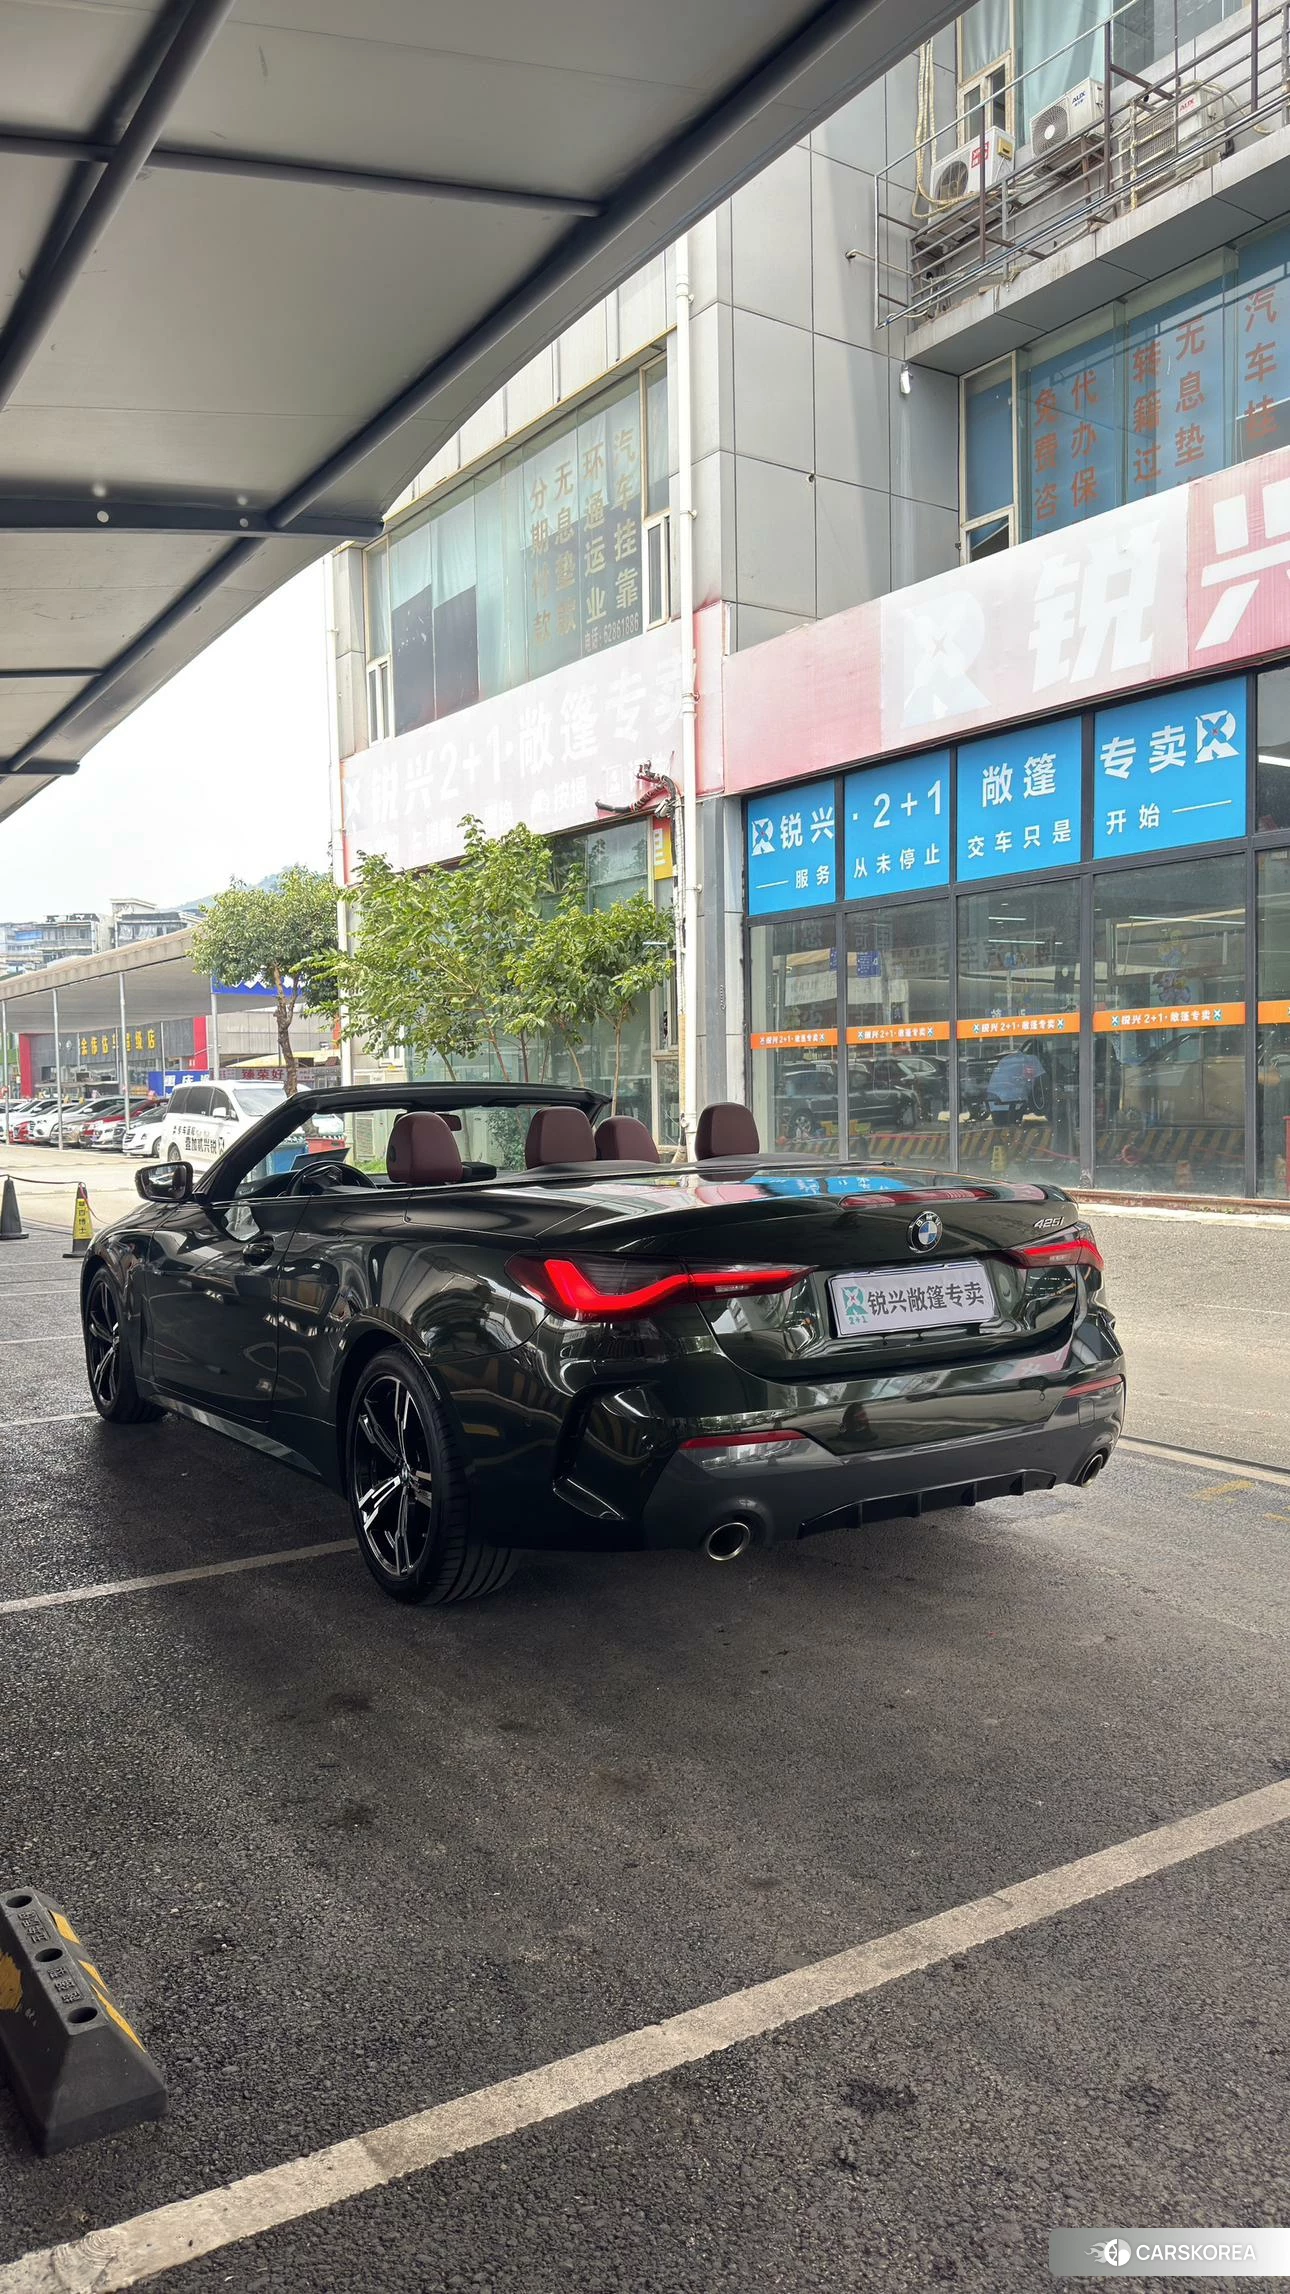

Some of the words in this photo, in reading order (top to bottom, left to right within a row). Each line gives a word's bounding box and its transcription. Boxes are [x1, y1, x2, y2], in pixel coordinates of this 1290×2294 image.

[1070, 369, 1098, 508] 代办保
[1132, 340, 1162, 497] 转籍过
[1175, 317, 1205, 484] 无息垫
[582, 441, 607, 625] 环通运业
[613, 428, 639, 610] 汽车挂靠
[779, 806, 836, 850] 锐兴
[982, 752, 1058, 808] 敞篷
[1100, 724, 1187, 781] 专卖
[795, 864, 831, 890] 服务
[853, 843, 942, 880] 从未停止
[967, 819, 1072, 859] 交车只是
[1106, 803, 1161, 836] 开始
[868, 1282, 985, 1316] 锐兴敞篷专卖
